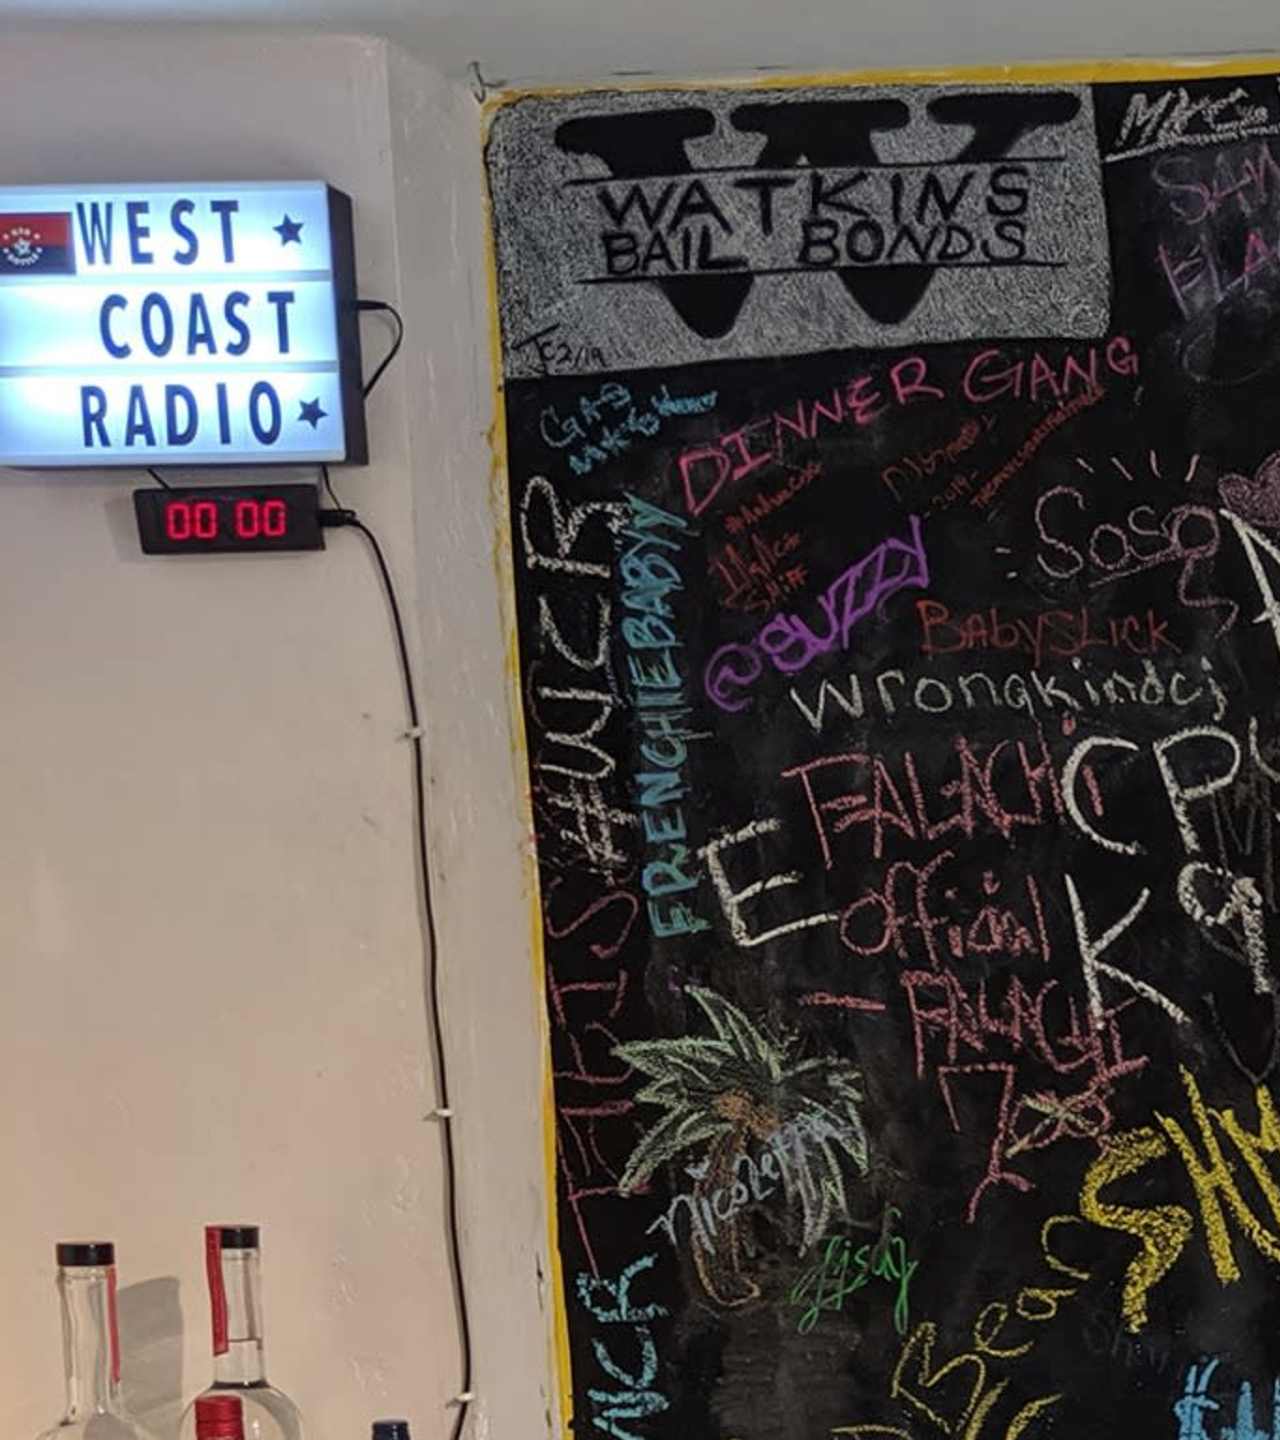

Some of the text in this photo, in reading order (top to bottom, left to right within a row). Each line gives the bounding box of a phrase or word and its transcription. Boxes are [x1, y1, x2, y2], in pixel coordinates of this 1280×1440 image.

[75, 200, 240, 266] WEST
[600, 165, 1030, 236] WATKINS
[600, 219, 1029, 276] BAIL BONDS
[99, 291, 295, 360] COAST
[80, 381, 282, 447] RADIO
[679, 355, 943, 516] DINNER
[963, 336, 1139, 401] GANG
